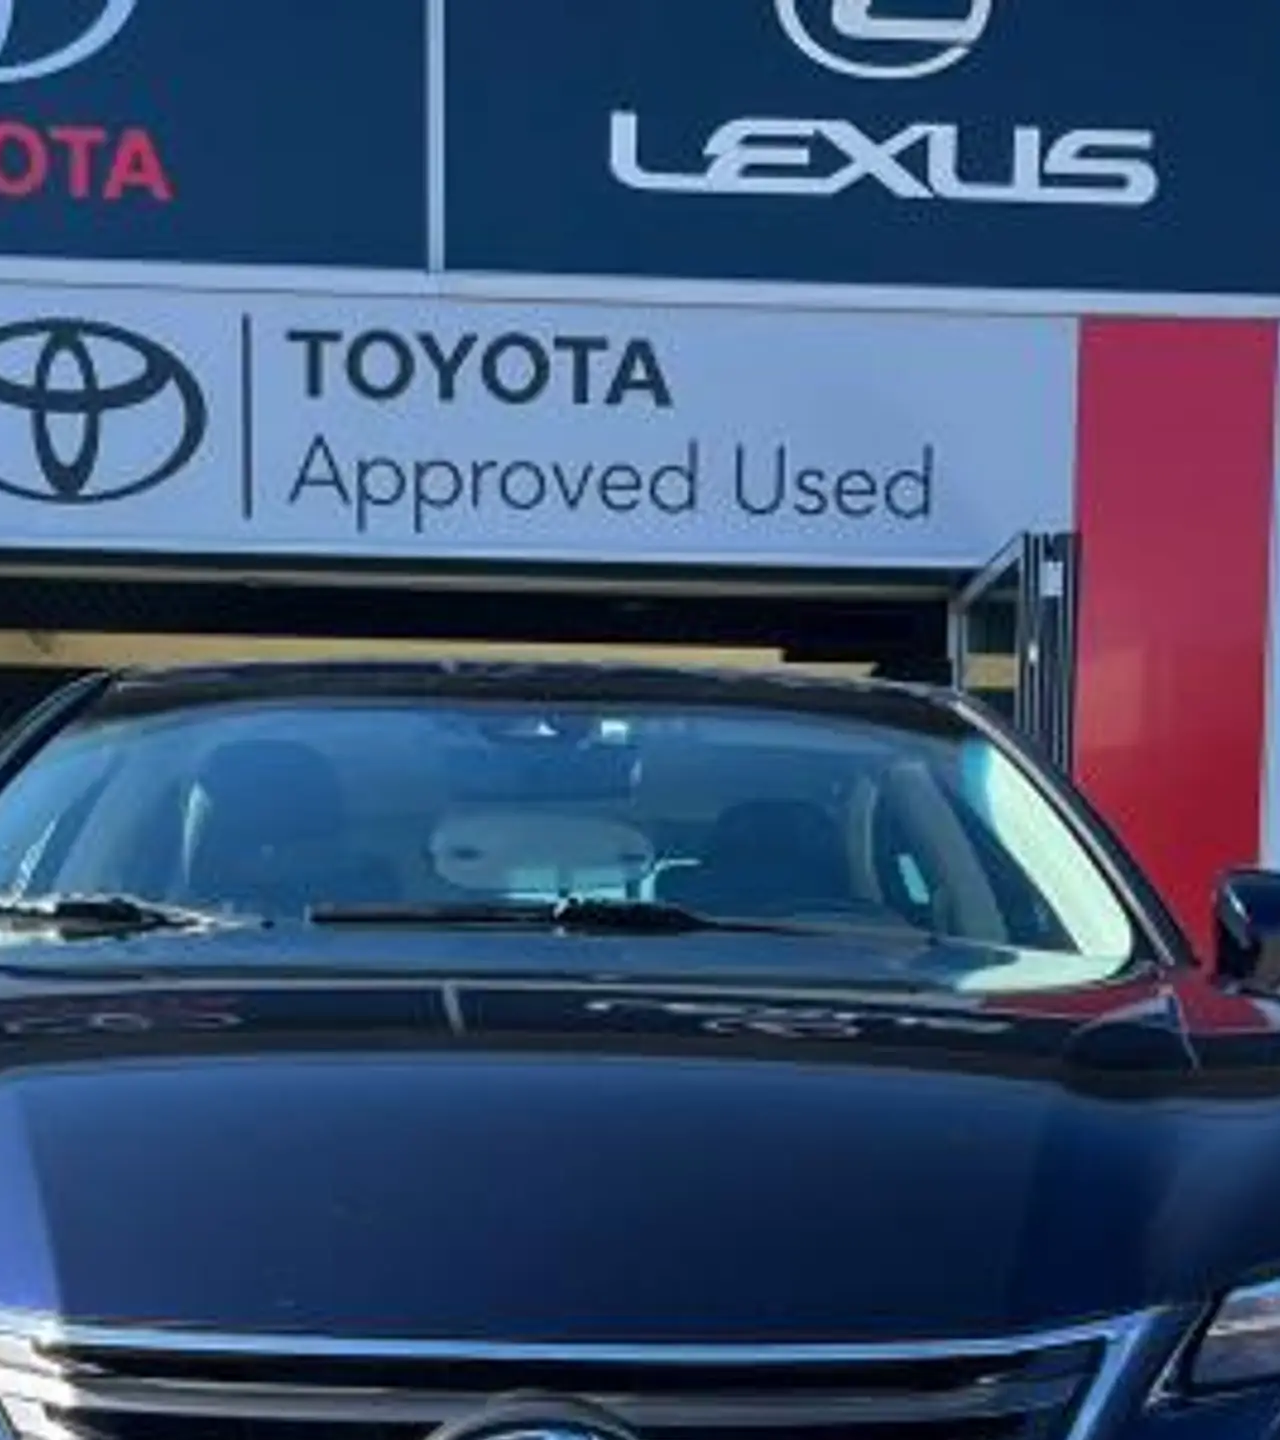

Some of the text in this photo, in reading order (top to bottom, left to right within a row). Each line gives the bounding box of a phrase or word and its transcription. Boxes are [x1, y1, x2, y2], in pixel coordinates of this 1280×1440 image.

[609, 110, 1158, 205] LEXUS
[284, 328, 674, 408] TOYOTA
[287, 433, 934, 534] Approved Used
